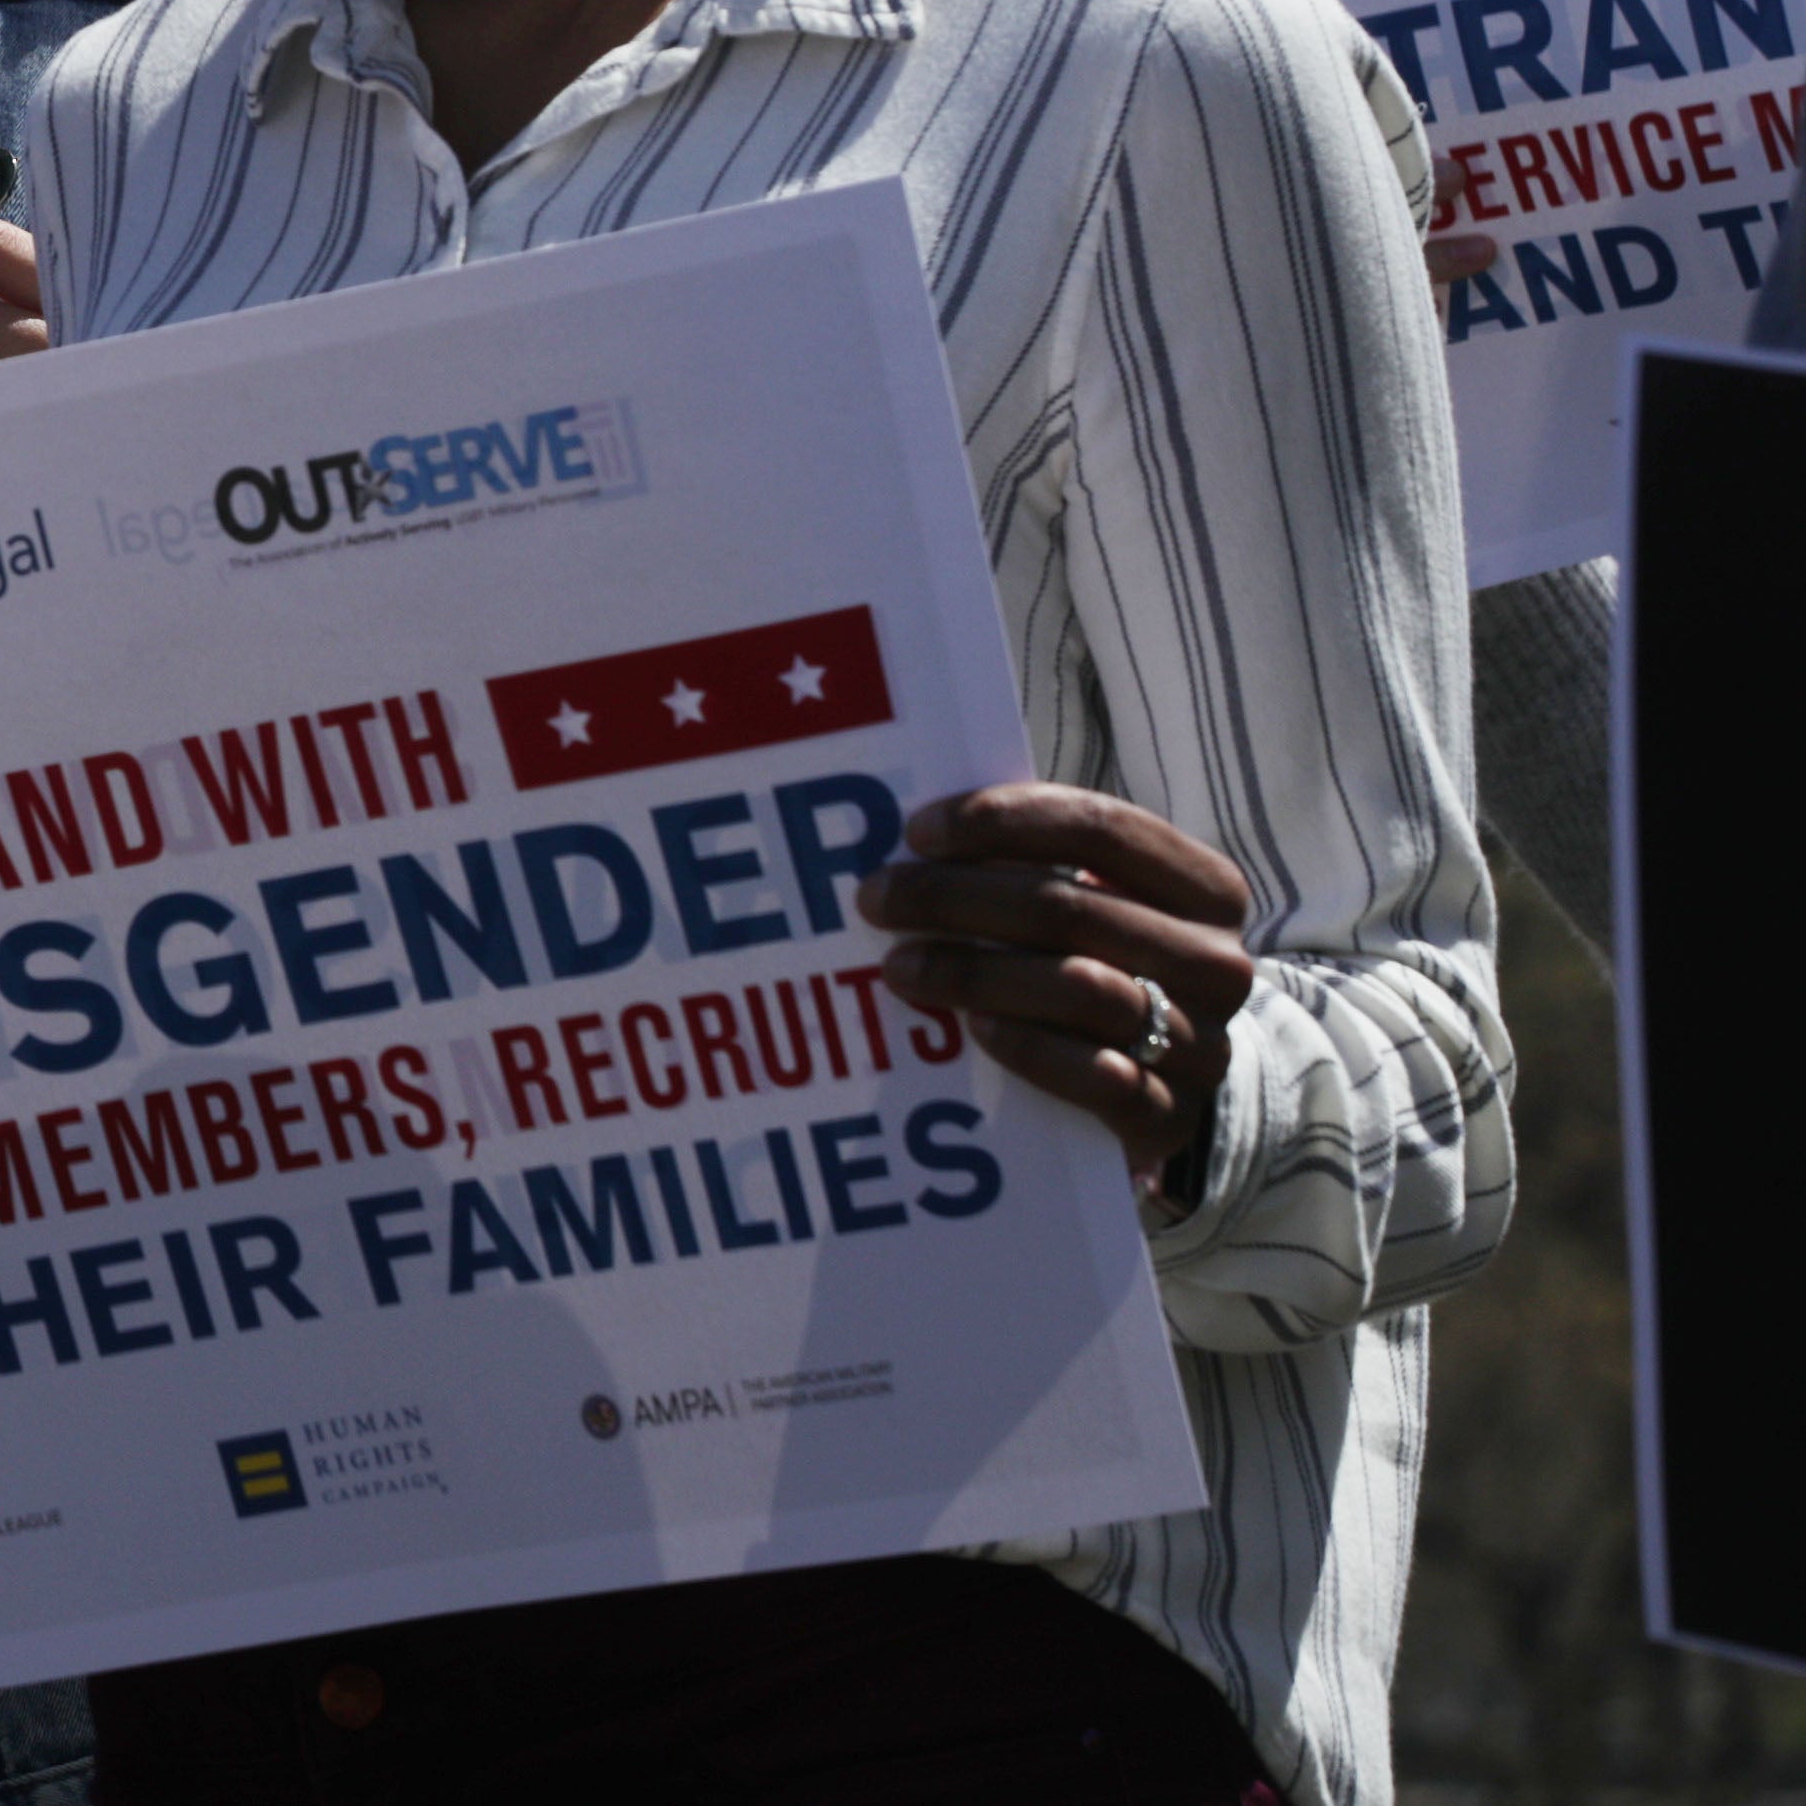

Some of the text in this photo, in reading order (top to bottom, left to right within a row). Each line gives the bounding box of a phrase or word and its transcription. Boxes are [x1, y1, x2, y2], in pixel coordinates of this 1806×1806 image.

[1446, 224, 1680, 345] AND
[180, 690, 469, 847] WITH
[492, 964, 965, 1132] RECRUITS
[346, 1098, 1005, 1308] FAMILIES
[302, 1404, 423, 1444] HUMAN
[312, 1438, 433, 1477] RIGHTS
[634, 1386, 724, 1428] AMPA
